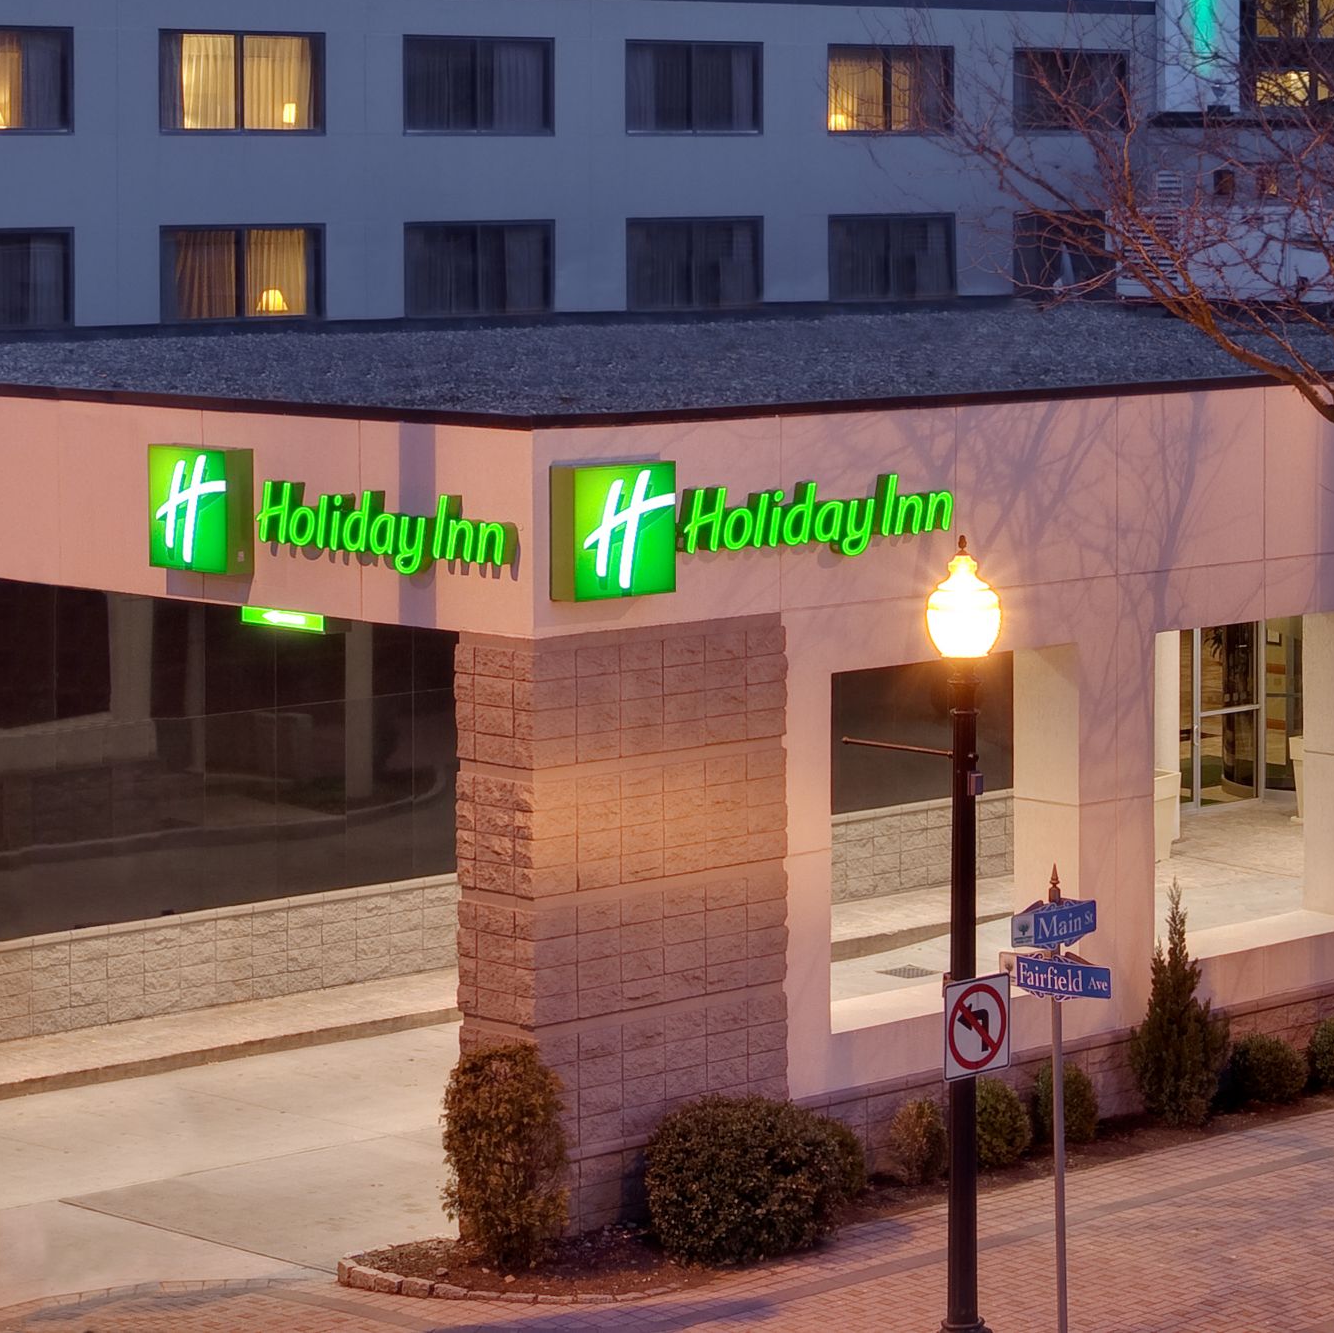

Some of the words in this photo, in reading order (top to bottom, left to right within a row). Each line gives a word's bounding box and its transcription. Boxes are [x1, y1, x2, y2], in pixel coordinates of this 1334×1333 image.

[255, 480, 425, 575] Holiday
[432, 494, 505, 566] Inn
[683, 481, 875, 556] Holiday
[881, 473, 954, 537] Inn
[1038, 913, 1082, 940] Main
[1084, 910, 1094, 925] St
[1019, 962, 1083, 992] Fairfield
[1087, 977, 1108, 991] Ave
